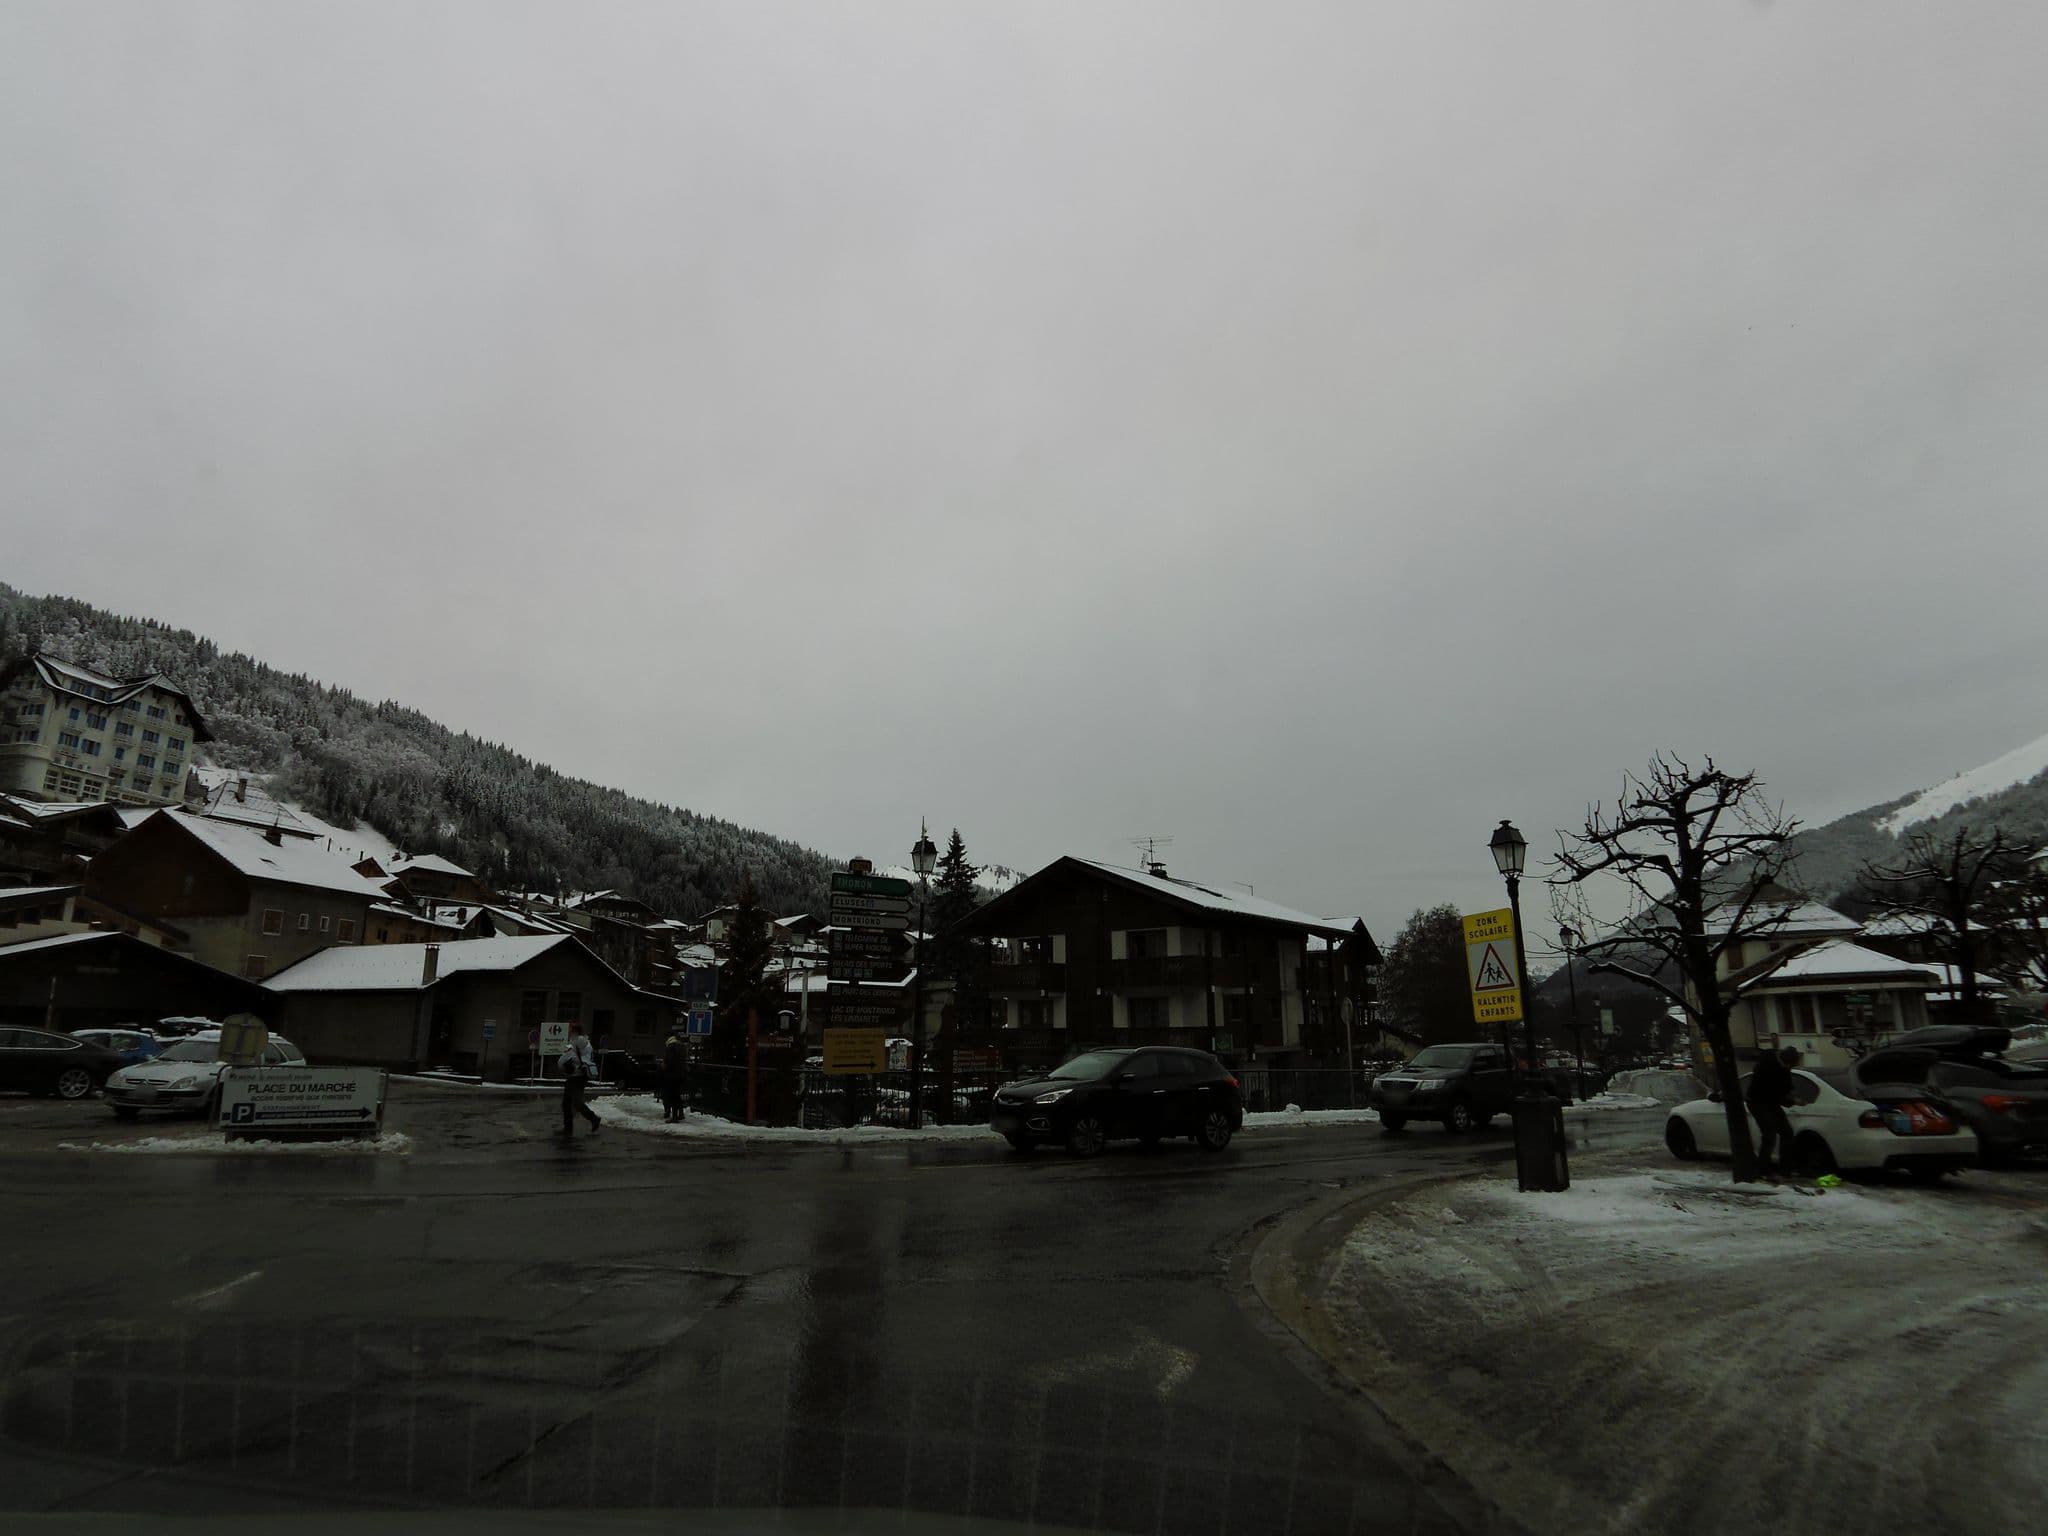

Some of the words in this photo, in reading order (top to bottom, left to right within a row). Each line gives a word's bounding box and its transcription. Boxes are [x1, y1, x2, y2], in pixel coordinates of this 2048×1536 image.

[833, 915, 881, 926] MONTRIOND
[1476, 915, 1498, 926] ZONE
[1469, 925, 1509, 939] SCOLAIRE
[1477, 994, 1516, 1006] RALENTIR
[1480, 1006, 1515, 1017] ENFANTS
[248, 1083, 287, 1094] PLACE
[289, 1083, 306, 1093] DU
[307, 1081, 357, 1093] MARCHÉ
[237, 1106, 249, 1121] P
